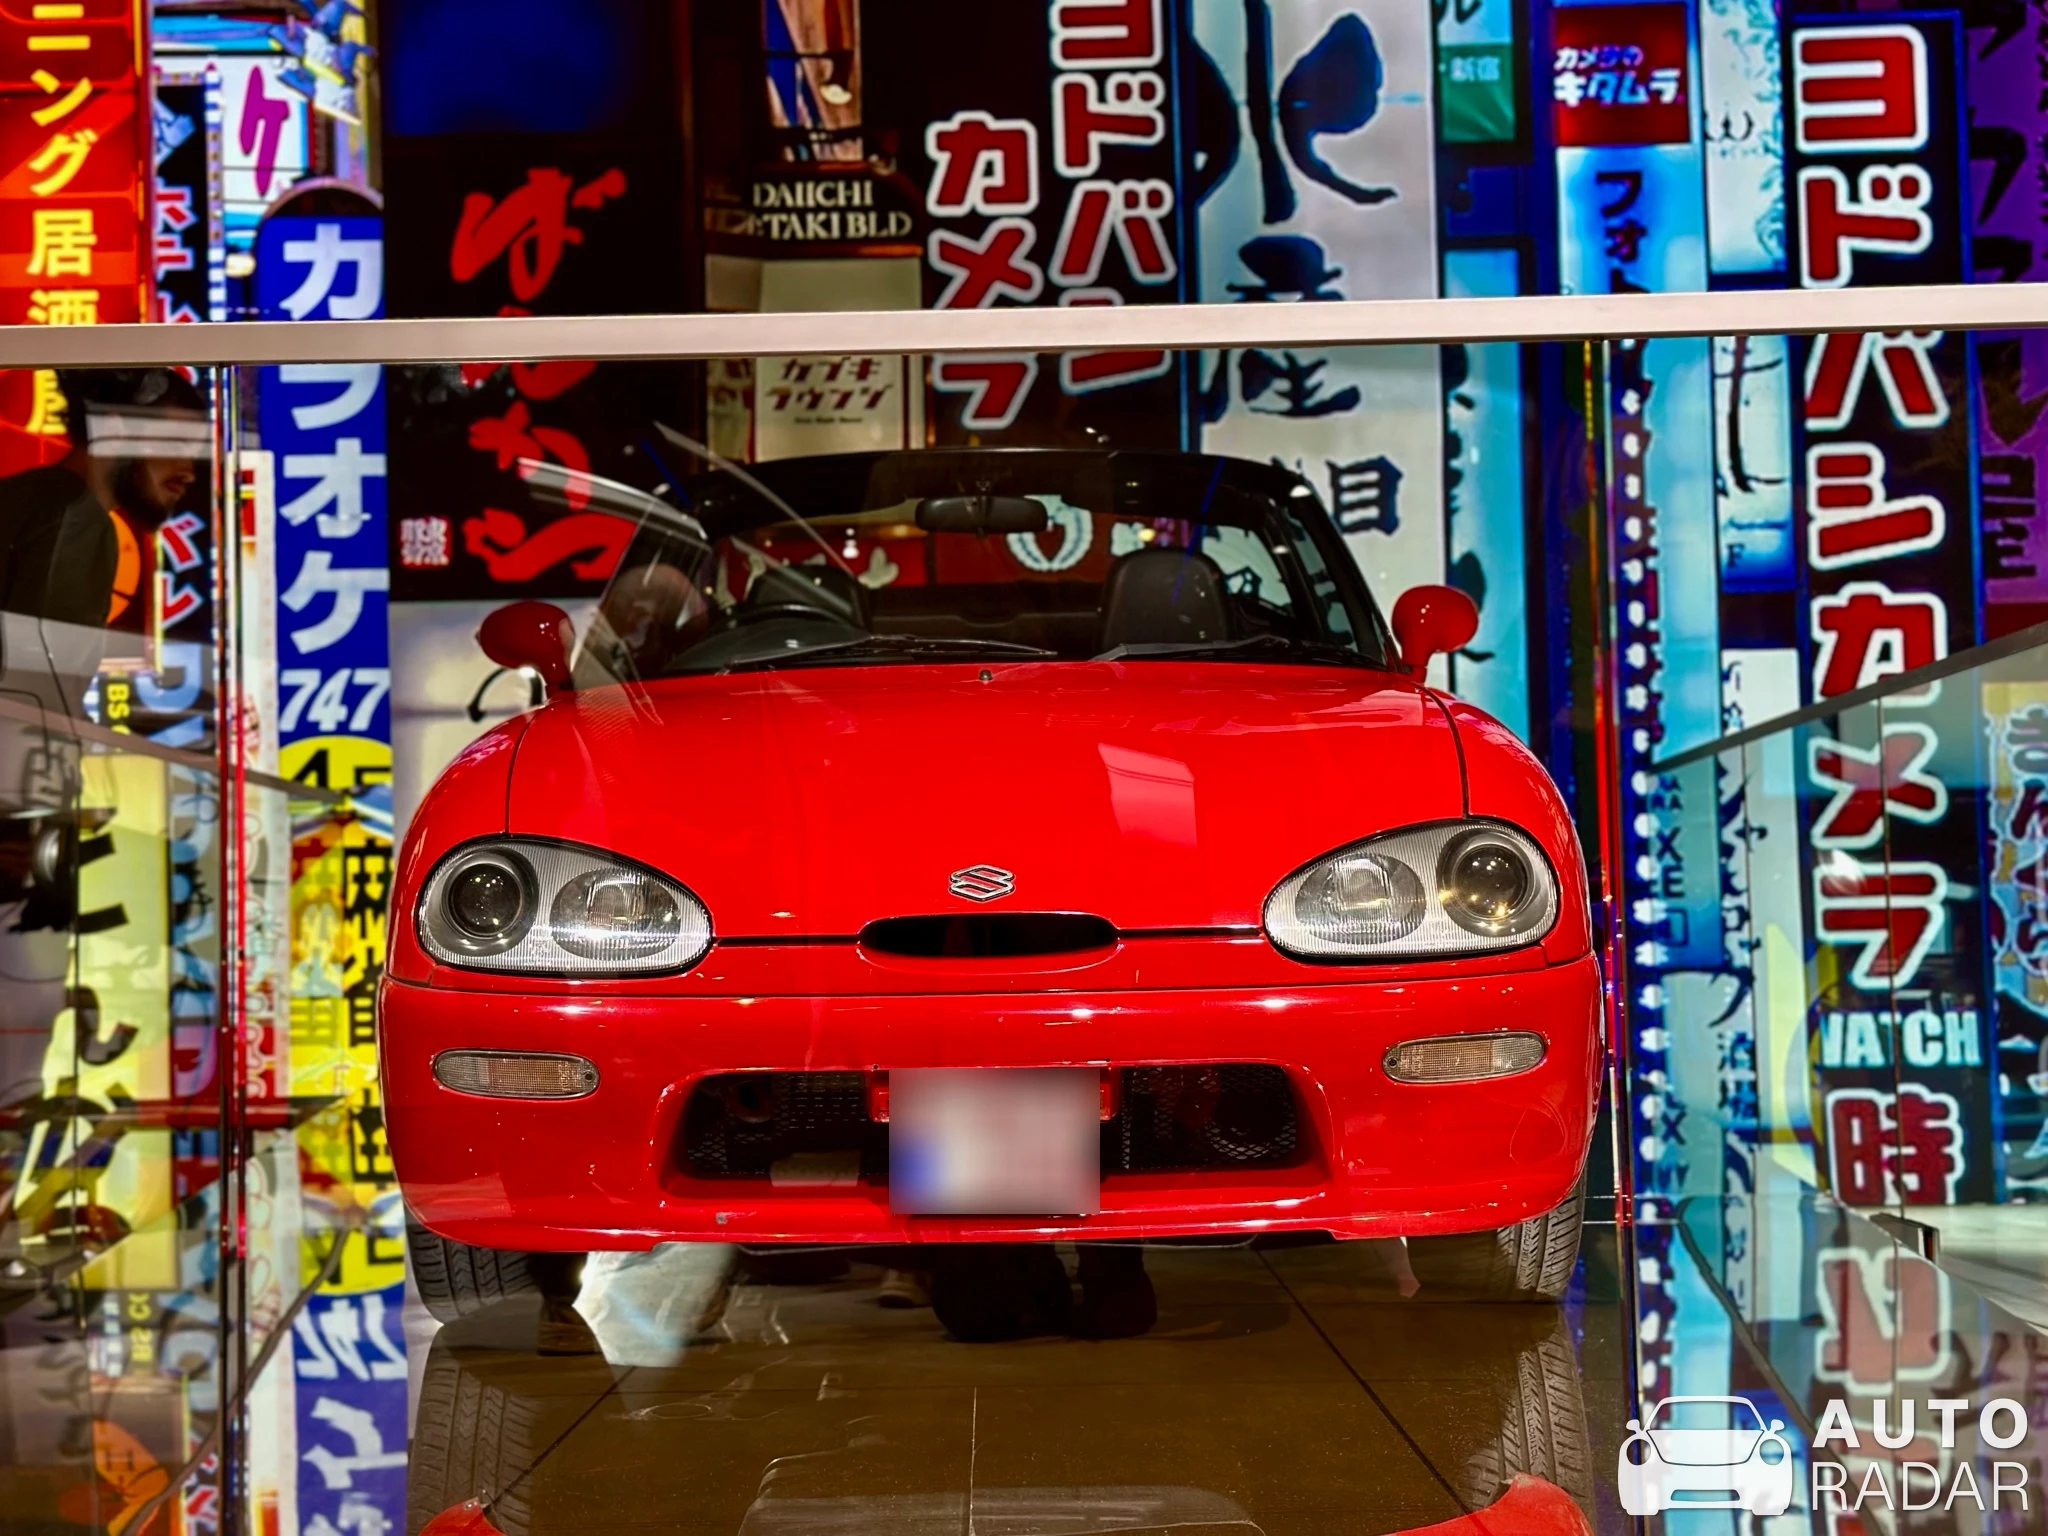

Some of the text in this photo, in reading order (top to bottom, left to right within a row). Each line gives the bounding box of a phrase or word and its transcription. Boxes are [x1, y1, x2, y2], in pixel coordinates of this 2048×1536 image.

[277, 222, 390, 656] カラオケ
[279, 667, 392, 733] 747
